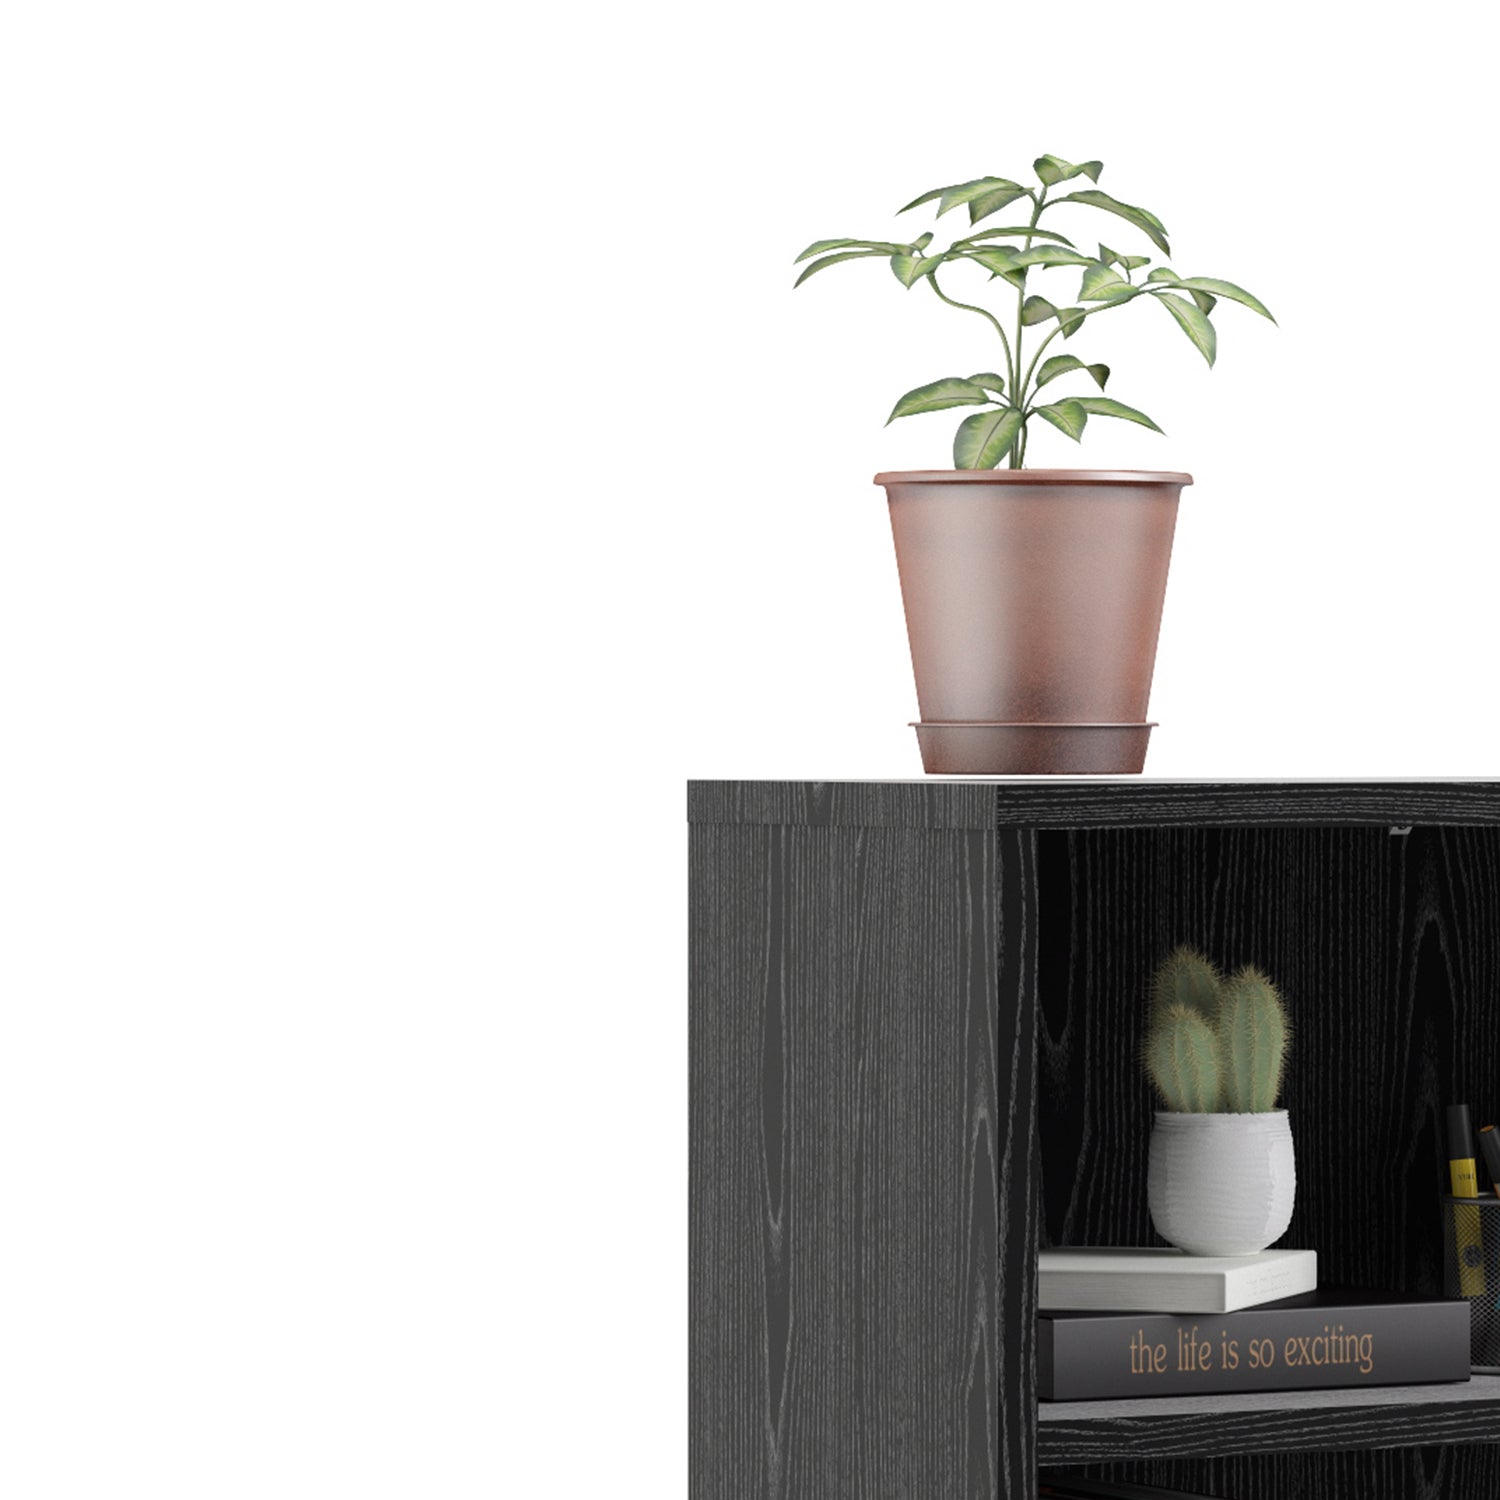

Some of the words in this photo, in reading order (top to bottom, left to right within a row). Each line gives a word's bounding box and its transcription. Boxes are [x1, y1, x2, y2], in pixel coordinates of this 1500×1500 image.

[1130, 1329, 1167, 1373] the
[1177, 1326, 1212, 1371] life
[1222, 1330, 1239, 1369] is
[1248, 1338, 1275, 1368] so
[1284, 1325, 1374, 1374] exciting
